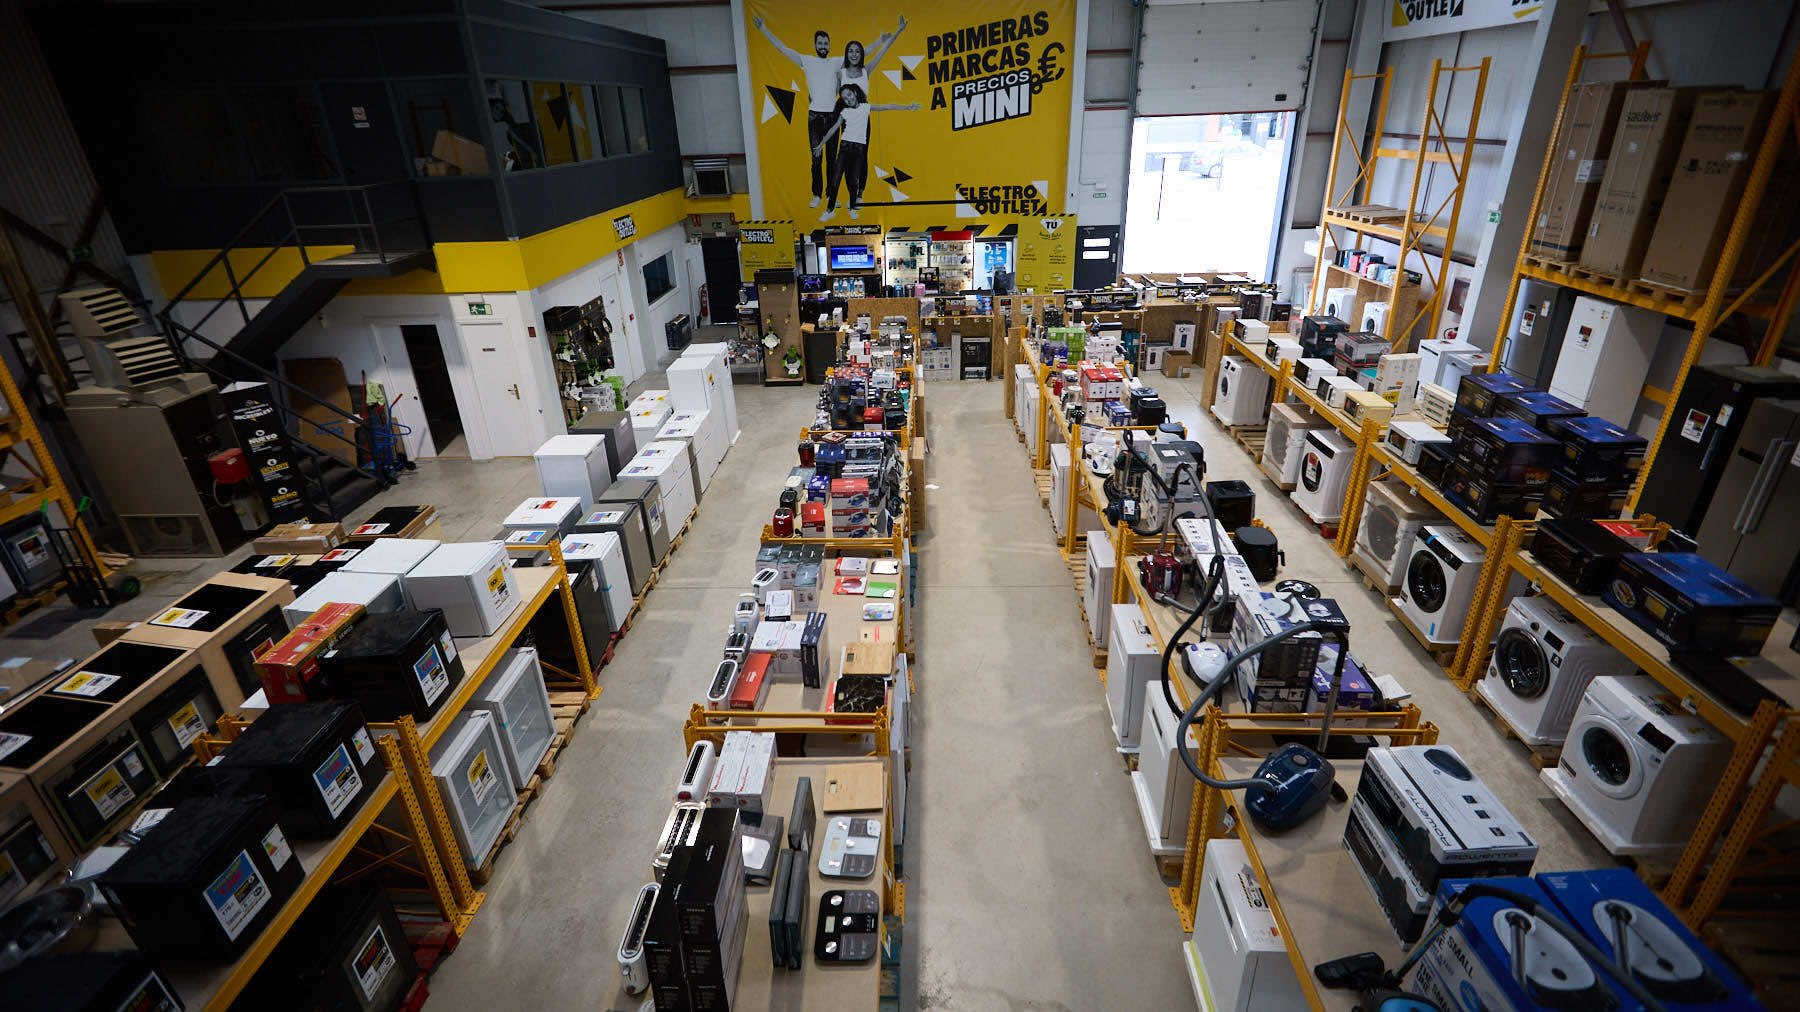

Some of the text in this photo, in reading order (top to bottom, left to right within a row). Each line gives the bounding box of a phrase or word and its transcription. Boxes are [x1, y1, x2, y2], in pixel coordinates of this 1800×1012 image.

[927, 11, 1049, 59] PRIMERAS
[929, 42, 1030, 85] MARCAS
[931, 87, 947, 110] A
[954, 70, 1030, 97] PRECIOS
[954, 83, 1030, 129] MINI
[957, 184, 1038, 201] ELECTRO
[975, 199, 1043, 214] OUTLET
[1447, 936, 1474, 977] SMALL
